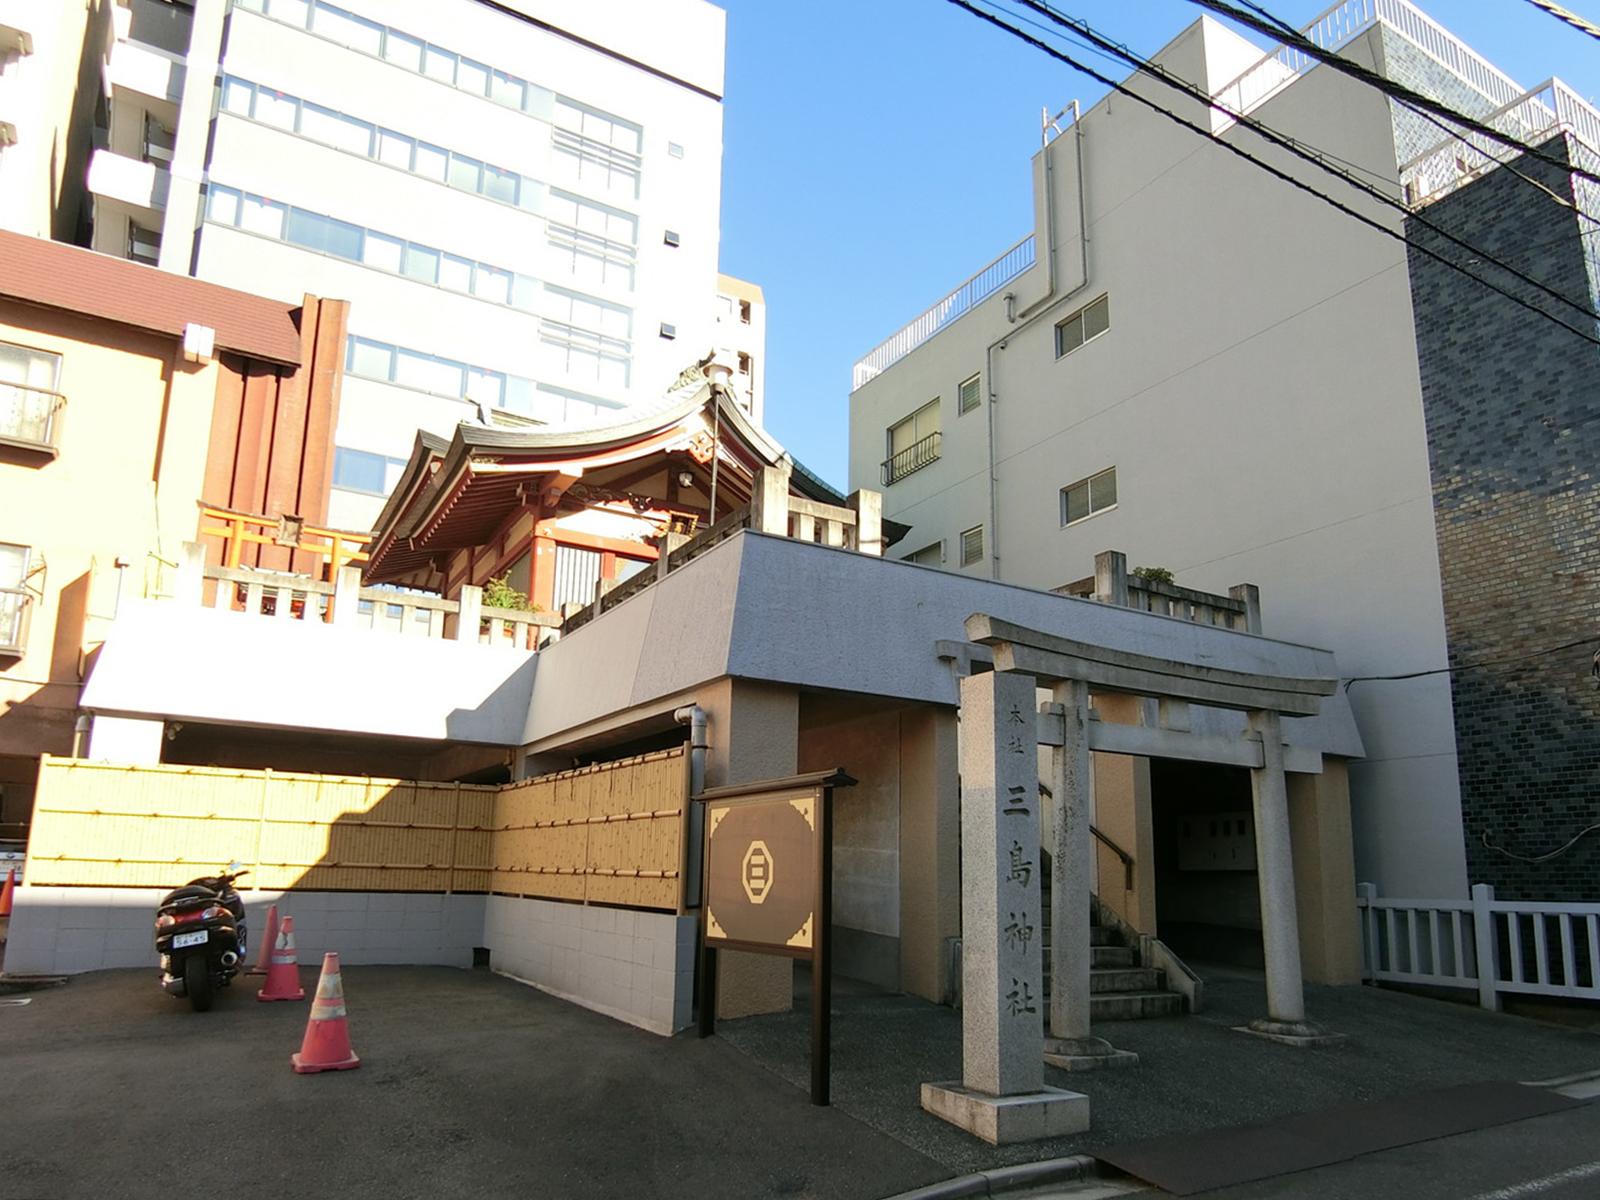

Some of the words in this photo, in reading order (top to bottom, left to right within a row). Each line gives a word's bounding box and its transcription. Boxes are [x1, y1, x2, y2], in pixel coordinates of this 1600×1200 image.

[1008, 704, 1025, 754] 本社
[1003, 786, 1036, 1016] 三島神社
